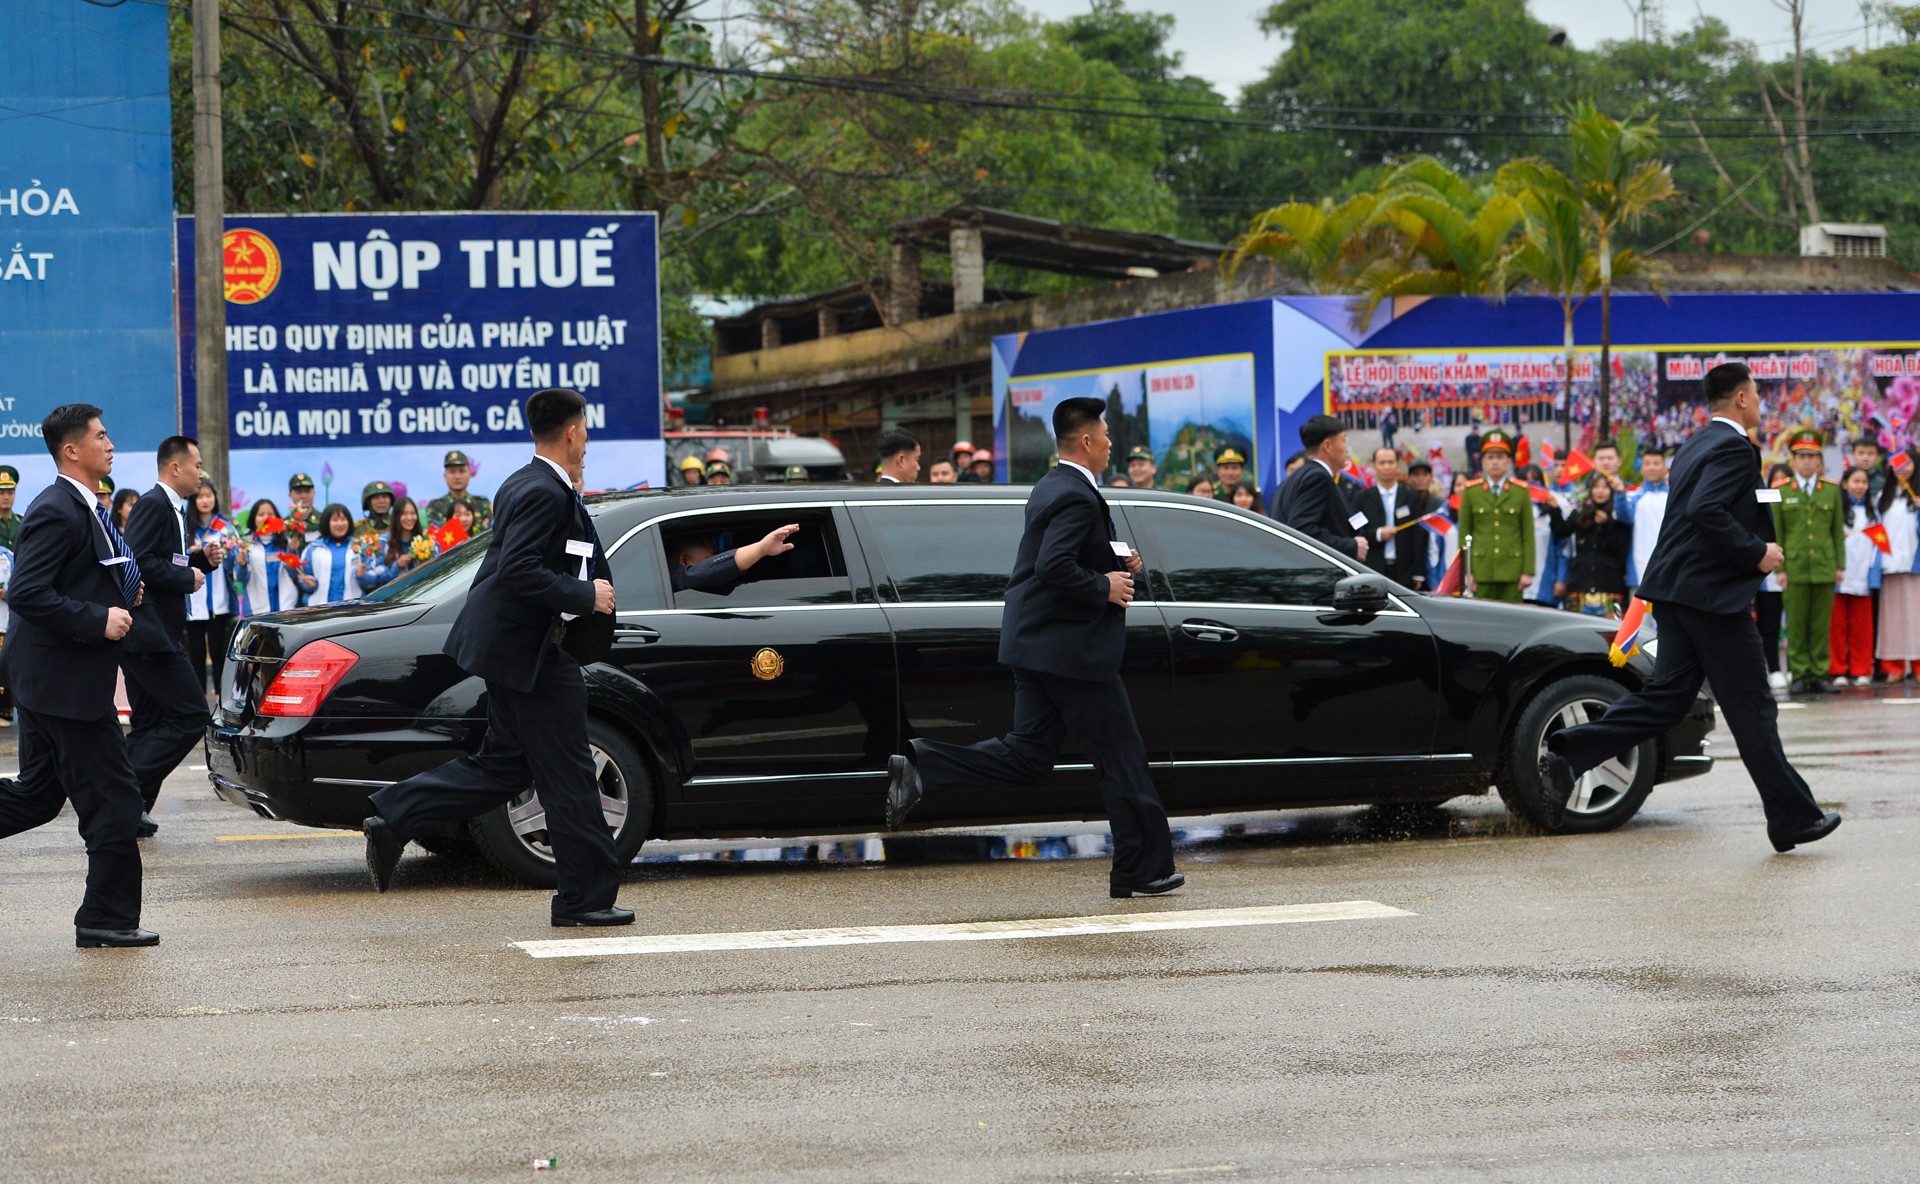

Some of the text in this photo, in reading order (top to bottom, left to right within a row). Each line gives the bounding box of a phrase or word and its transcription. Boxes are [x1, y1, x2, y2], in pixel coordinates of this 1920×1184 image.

[0, 242, 54, 281] ẮT
[312, 222, 621, 300] NỘP THUẾ
[225, 312, 627, 355] HEO QUY ĐỊNH CỦA PHÁP LUẬT
[244, 362, 278, 393] LÀ
[377, 365, 413, 396] VỤ
[418, 359, 455, 390] VÀ
[558, 360, 600, 392] LỢI
[1874, 357, 1903, 375] HOA
[235, 397, 525, 440] CỦA MỌI TỔ CHỨC, CÁ
